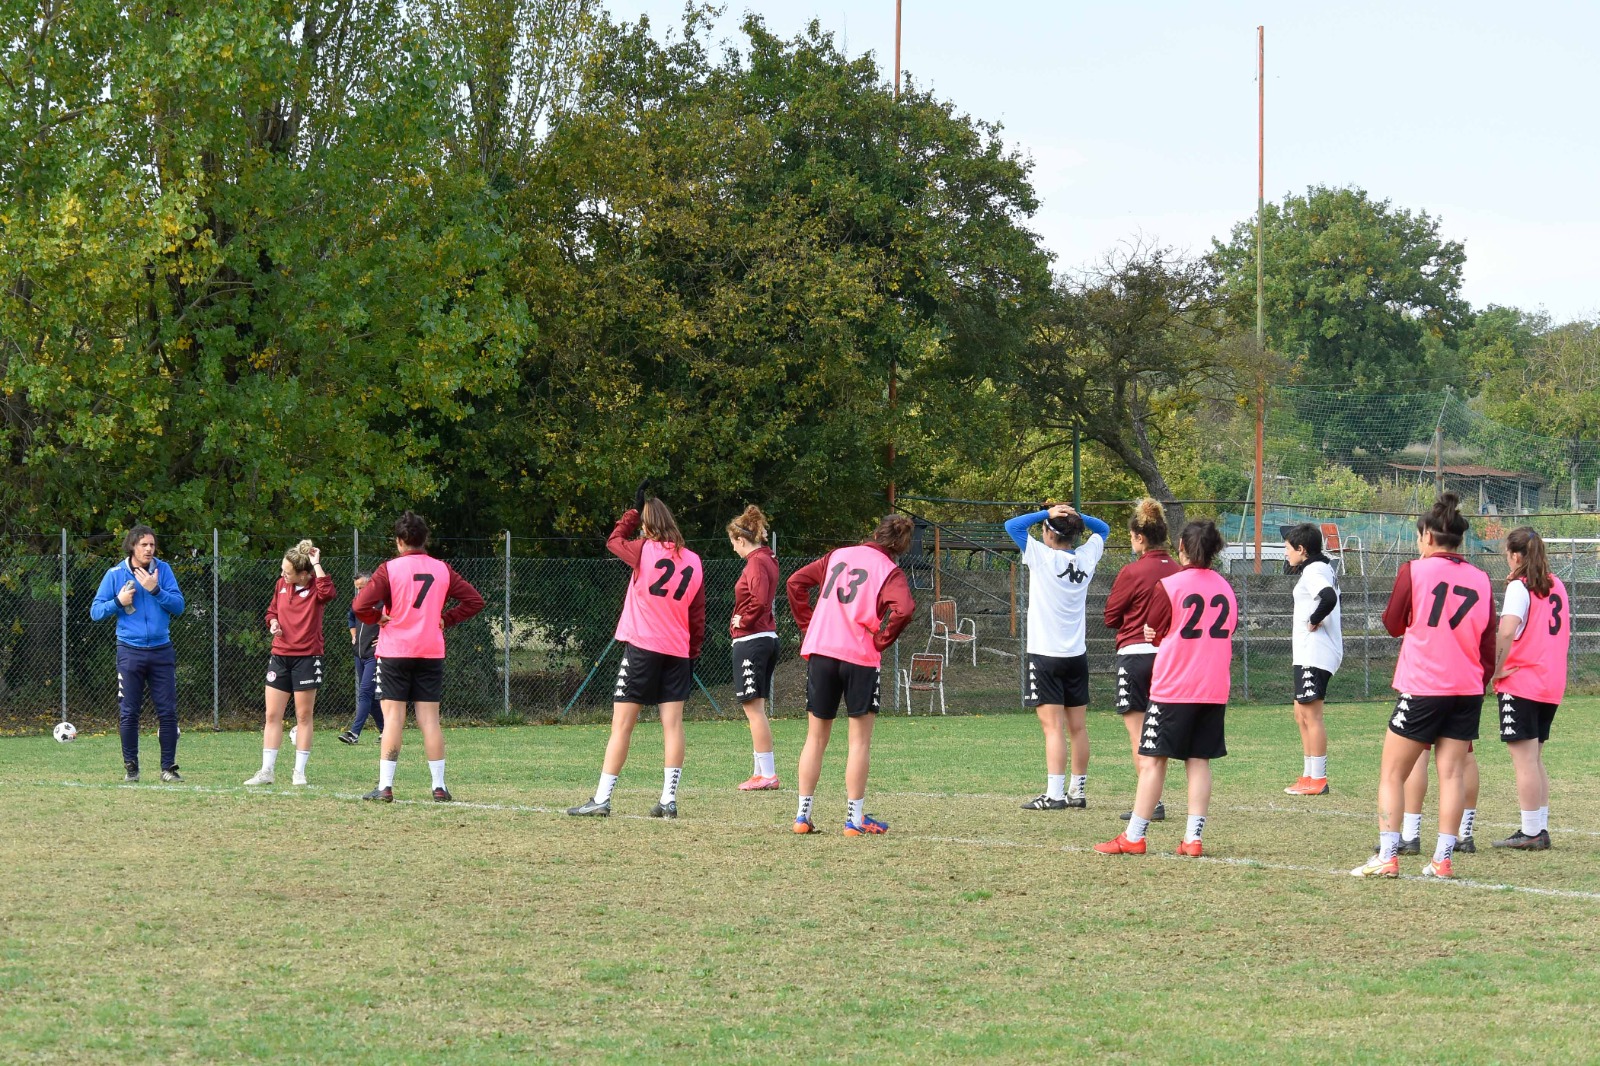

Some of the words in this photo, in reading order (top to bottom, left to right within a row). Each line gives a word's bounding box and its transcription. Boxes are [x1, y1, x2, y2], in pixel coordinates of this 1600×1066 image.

[413, 574, 435, 609] 7
[648, 558, 694, 601] 21
[822, 561, 868, 604] 13
[1180, 593, 1230, 640] 22
[1427, 581, 1480, 631] 17
[1548, 593, 1563, 636] 3
